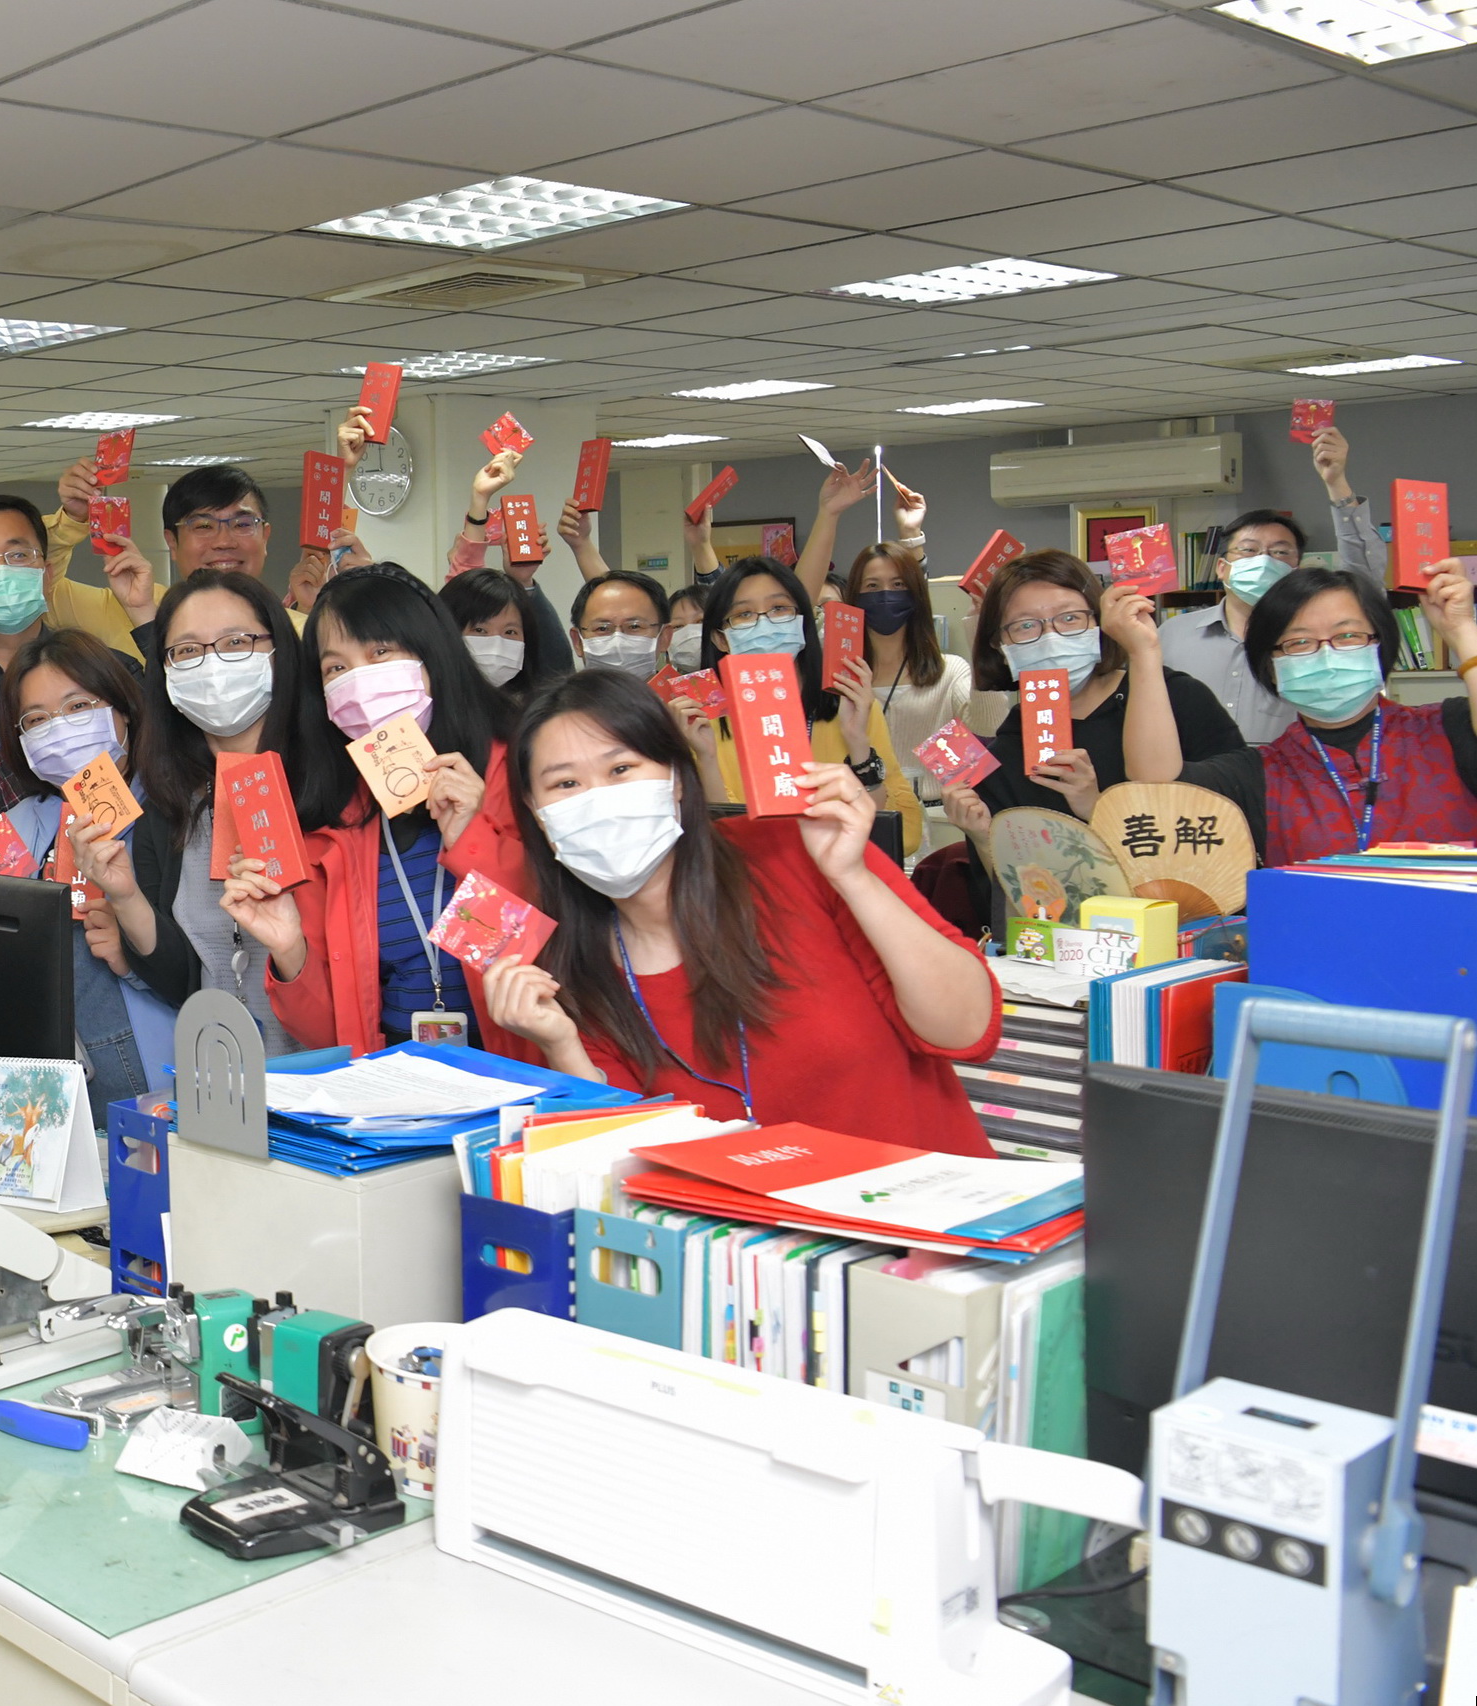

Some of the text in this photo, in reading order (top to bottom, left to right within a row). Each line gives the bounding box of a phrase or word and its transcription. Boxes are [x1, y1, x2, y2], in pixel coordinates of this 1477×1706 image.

[316, 490, 331, 540] 開山廟
[516, 520, 530, 554] 開山廟
[739, 669, 784, 684] 鹿谷鄉
[760, 714, 799, 797] 開山廟
[232, 771, 266, 794] 鹿谷鄉
[251, 809, 283, 878] 開山廟
[1122, 813, 1224, 858] 善解
[1059, 949, 1084, 961] 2020
[1088, 947, 1124, 966] CH
[651, 1380, 676, 1396] PLUS
